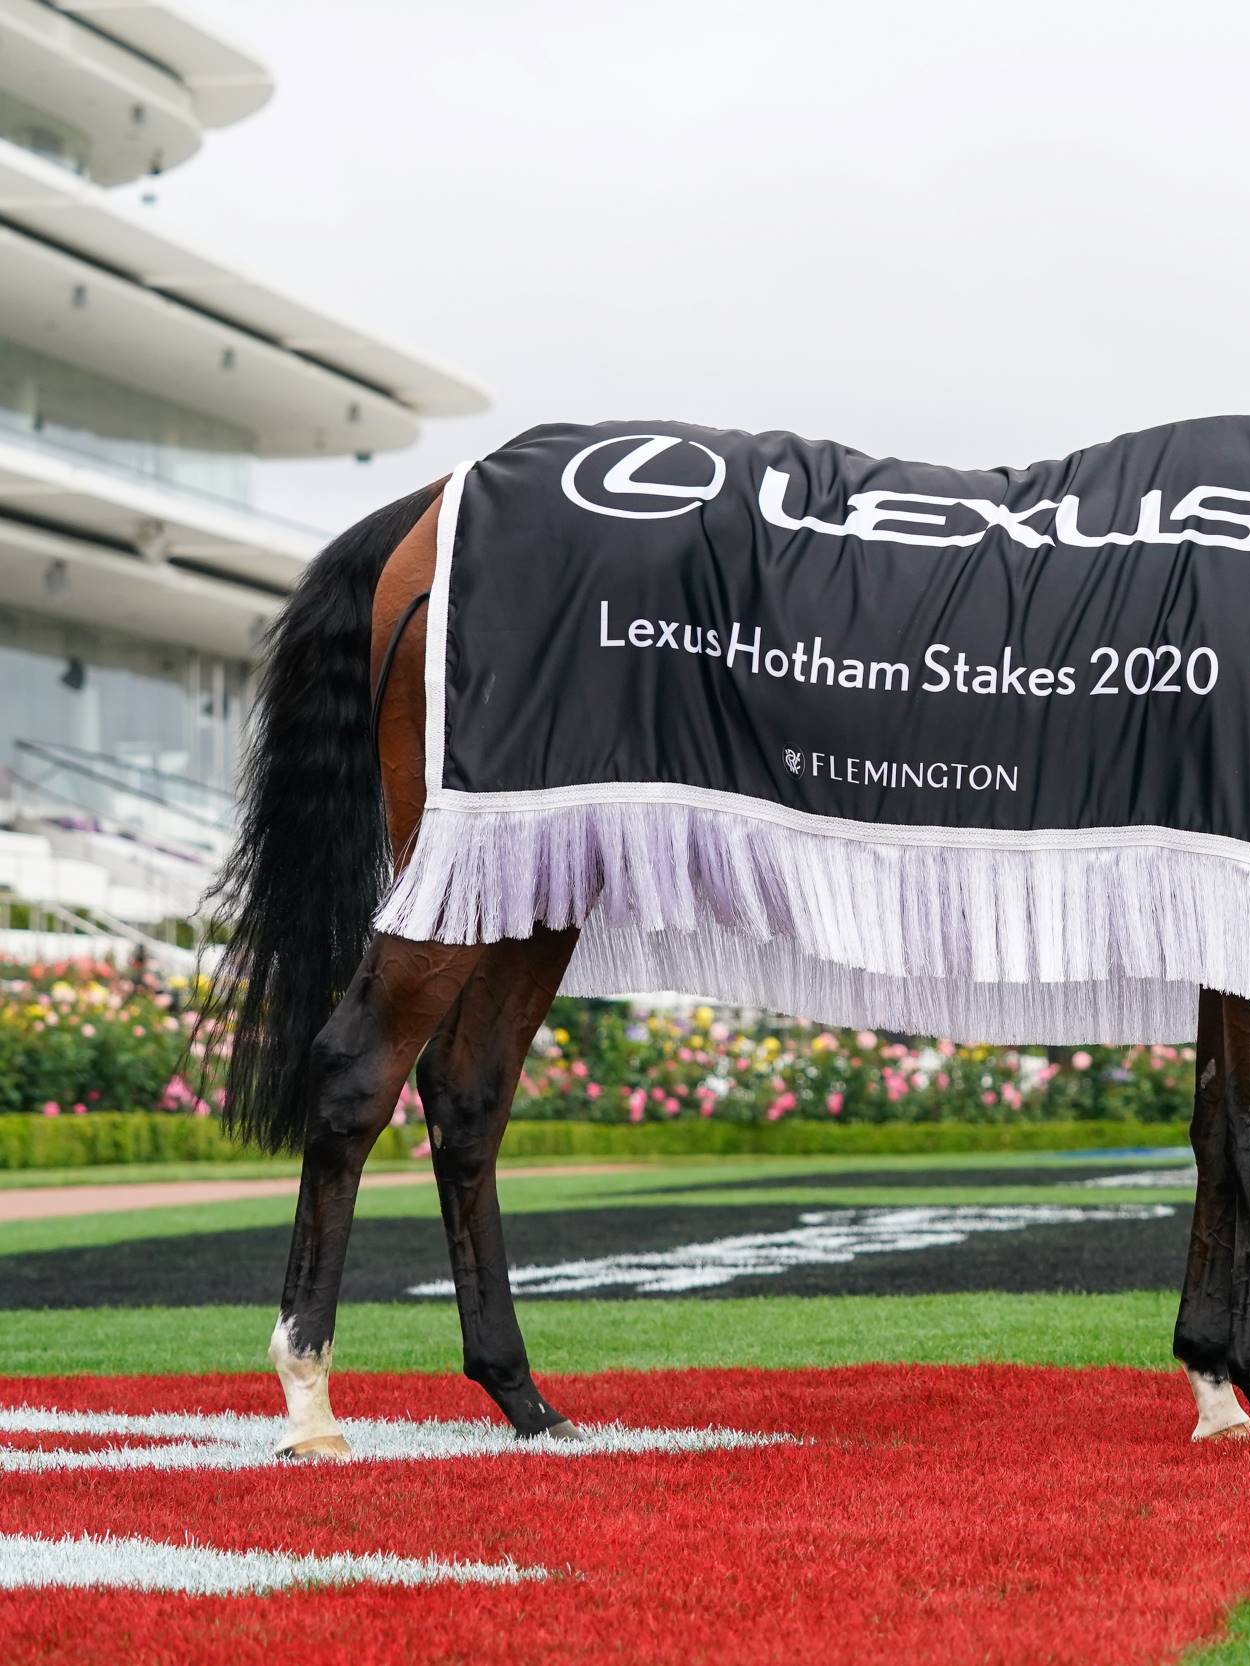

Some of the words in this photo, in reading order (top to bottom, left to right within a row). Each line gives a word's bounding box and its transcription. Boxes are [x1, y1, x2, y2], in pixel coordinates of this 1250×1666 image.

[600, 600, 723, 657] Lexus
[726, 621, 910, 692] Hotham
[921, 643, 1076, 697] Stakes
[1089, 645, 1219, 697] 2020
[812, 752, 1018, 792] FLEMINGTON
